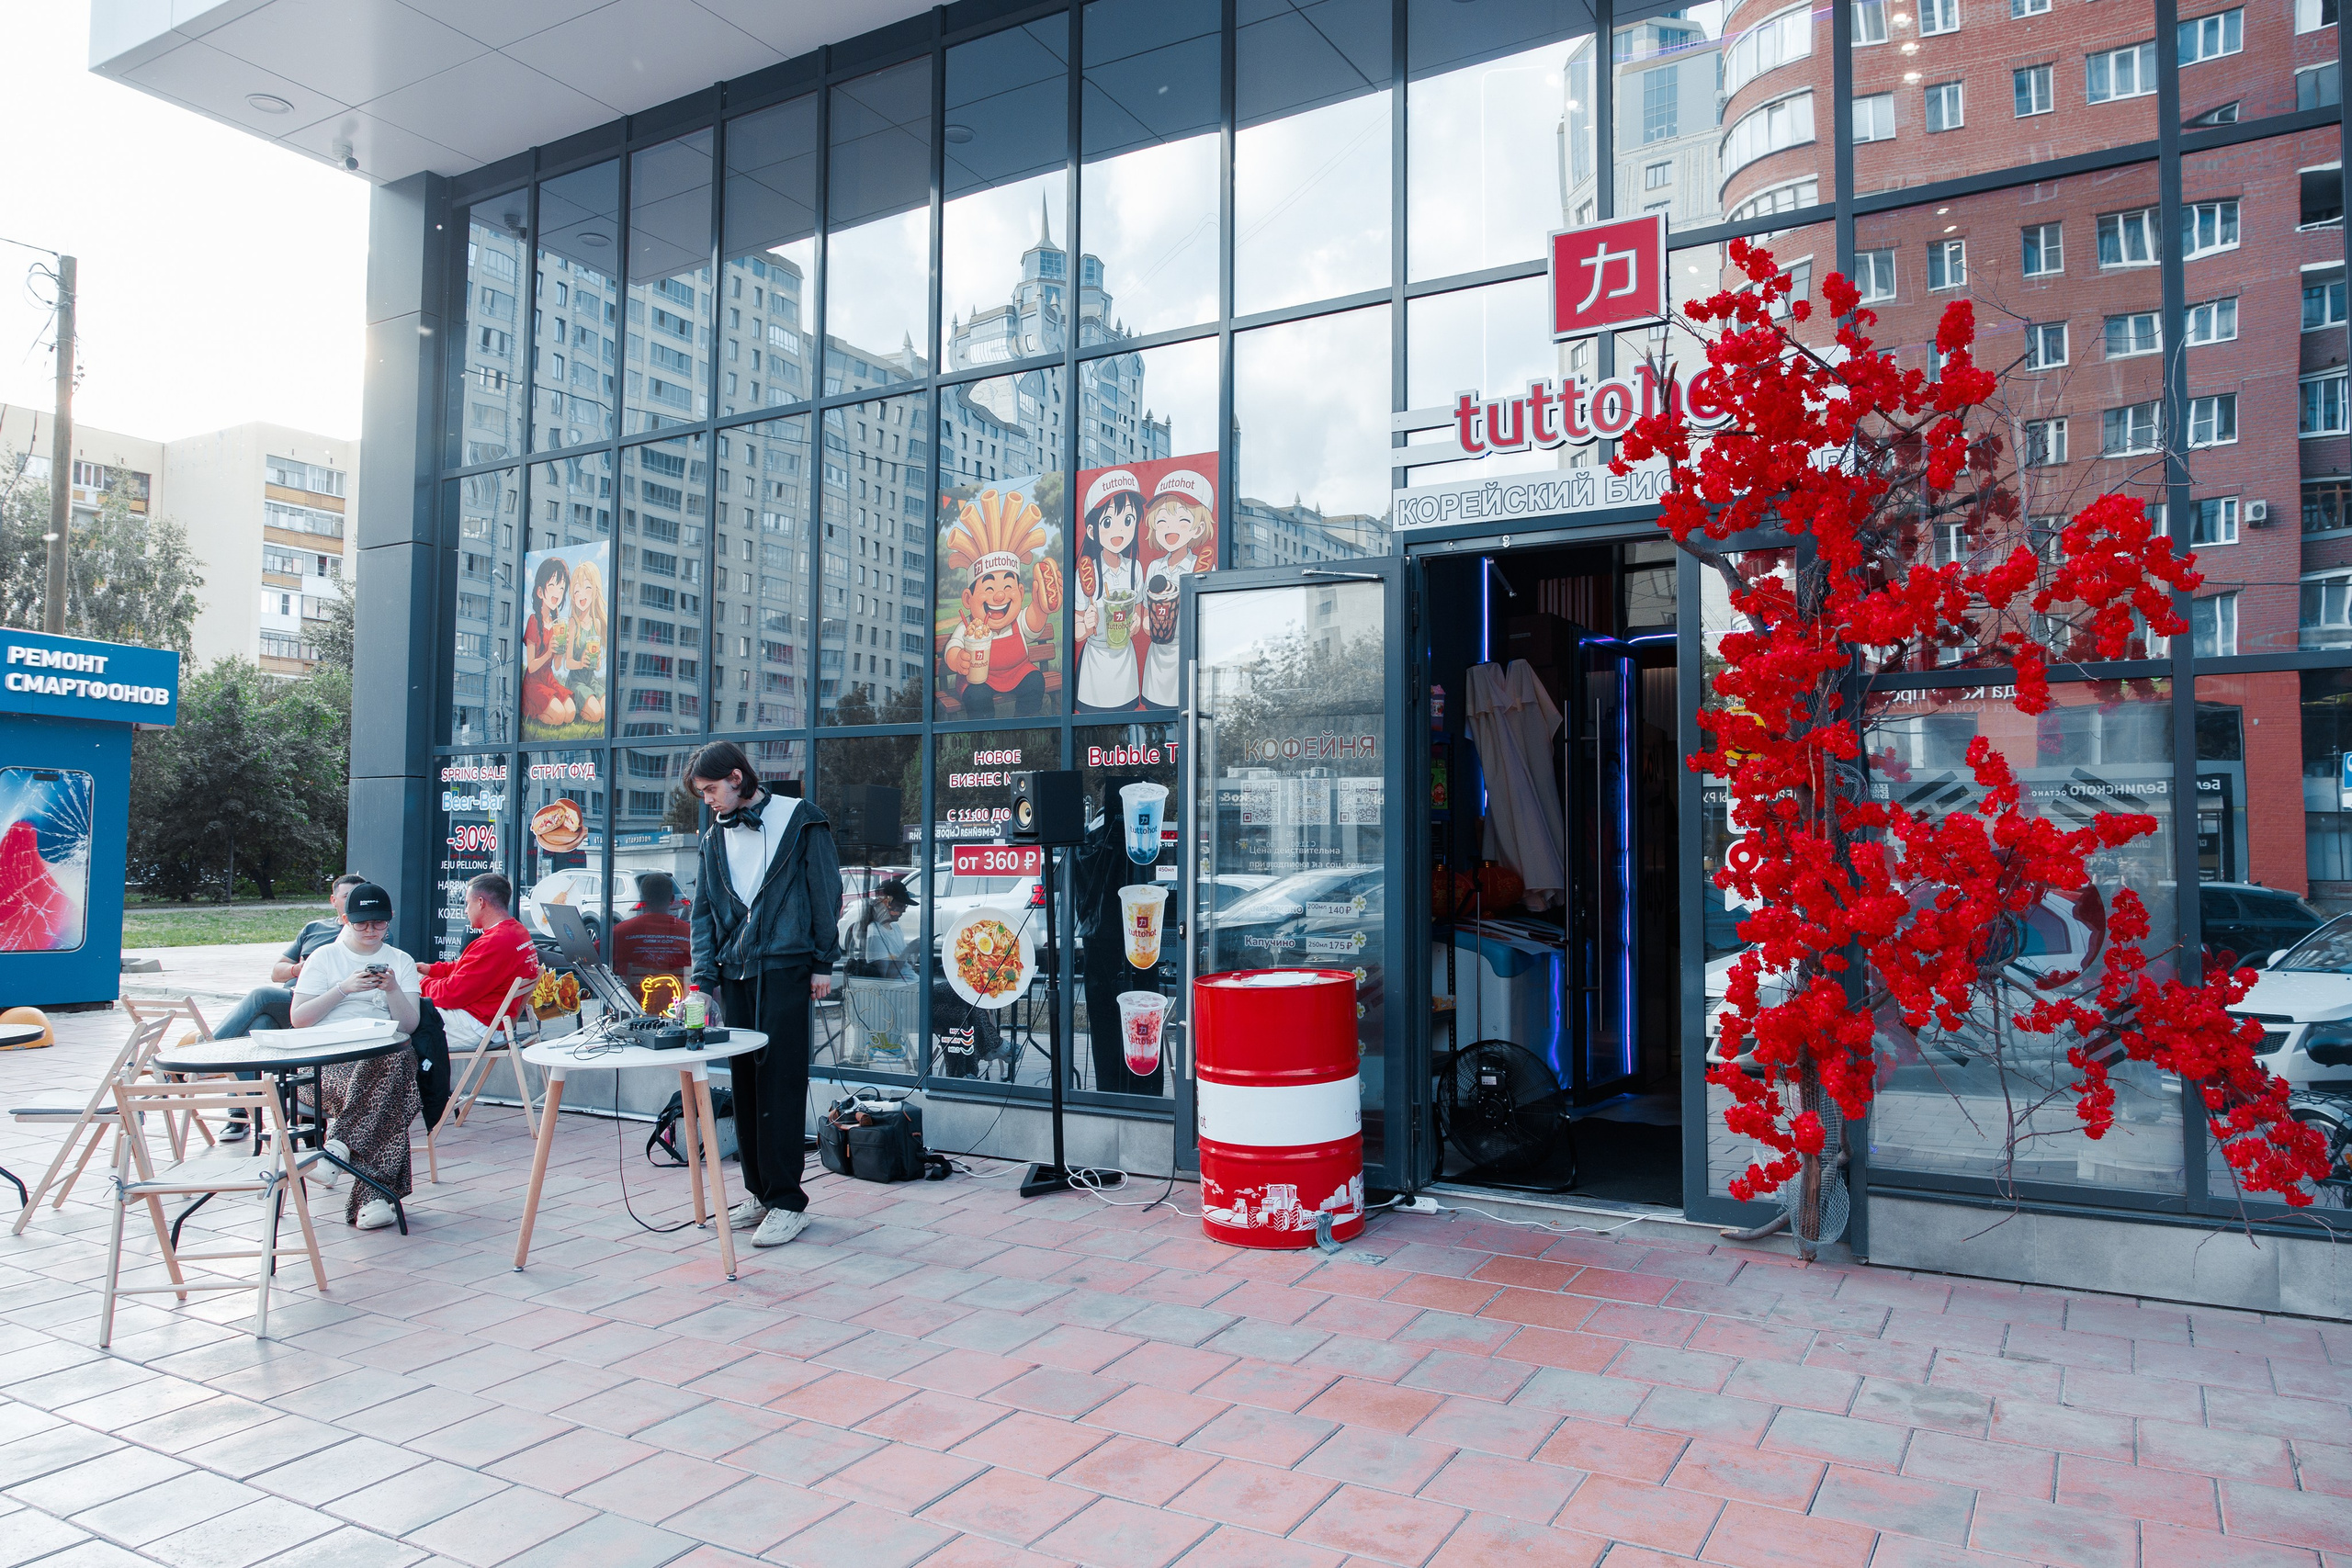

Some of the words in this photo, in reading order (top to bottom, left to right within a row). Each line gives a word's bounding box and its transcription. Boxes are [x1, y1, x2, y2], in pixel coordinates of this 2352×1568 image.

[1454, 361, 1744, 455] tuttoho
[1102, 476, 1135, 491] tuttohot
[1160, 478, 1194, 491] tuttohot
[1397, 470, 1596, 525] КОРЕЙСКИЙ
[985, 556, 1018, 570] tuttohot
[6, 645, 108, 674] РЕМОНТ
[5, 671, 170, 705] СМАРТФОНОВ
[1244, 730, 1376, 761] КОФЕЙНЯ
[974, 750, 1022, 765] НОВОЕ
[1088, 743, 1160, 766] Bubble
[441, 766, 478, 782] SPRING
[480, 765, 506, 780] SALE
[530, 763, 567, 780] СТРИТ
[568, 761, 596, 780] ФУД
[949, 772, 1001, 787] БИЗНЕС
[442, 790, 505, 811] Beer-Bar
[957, 809, 989, 822] 11:00
[447, 825, 497, 852] -30%
[1250, 845, 1272, 855] Цена
[1273, 845, 1340, 856] действительна
[441, 861, 455, 870] JEJU
[457, 861, 488, 870] PELLONG
[490, 861, 503, 870] ALE
[957, 856, 978, 870] от
[983, 851, 1019, 870] 360
[1326, 862, 1344, 870] соц.
[437, 908, 466, 919] KOZEL
[435, 936, 462, 945] TAIWAN
[1128, 928, 1157, 938] tuttohot
[1245, 935, 1295, 949] Капучино
[438, 951, 457, 960] BEER
